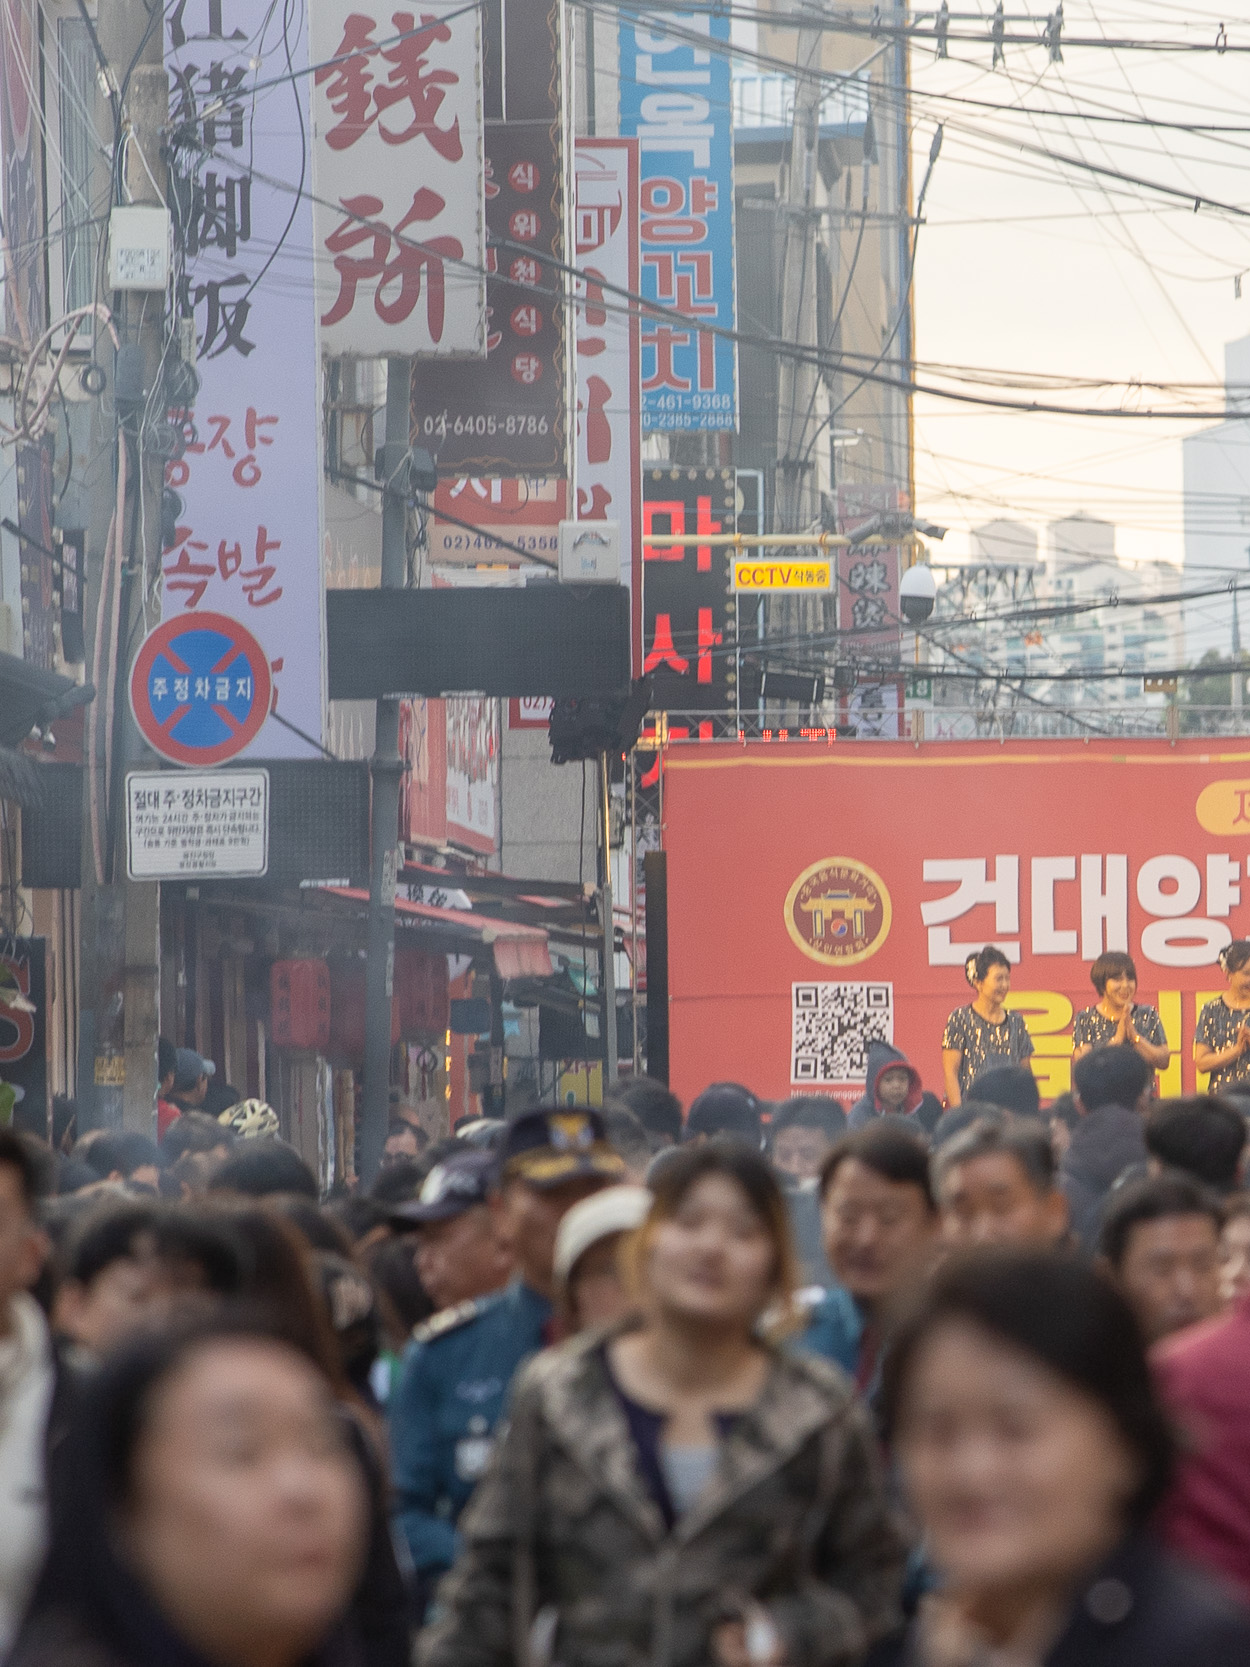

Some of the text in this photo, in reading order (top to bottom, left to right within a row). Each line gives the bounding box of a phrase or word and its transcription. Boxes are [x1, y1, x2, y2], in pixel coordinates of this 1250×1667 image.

[423, 415, 549, 437] 02-6405-8786
[162, 525, 283, 608] 족발
[738, 567, 792, 585] CCTV
[152, 676, 251, 701] 주정차금지
[134, 789, 160, 810] 절대
